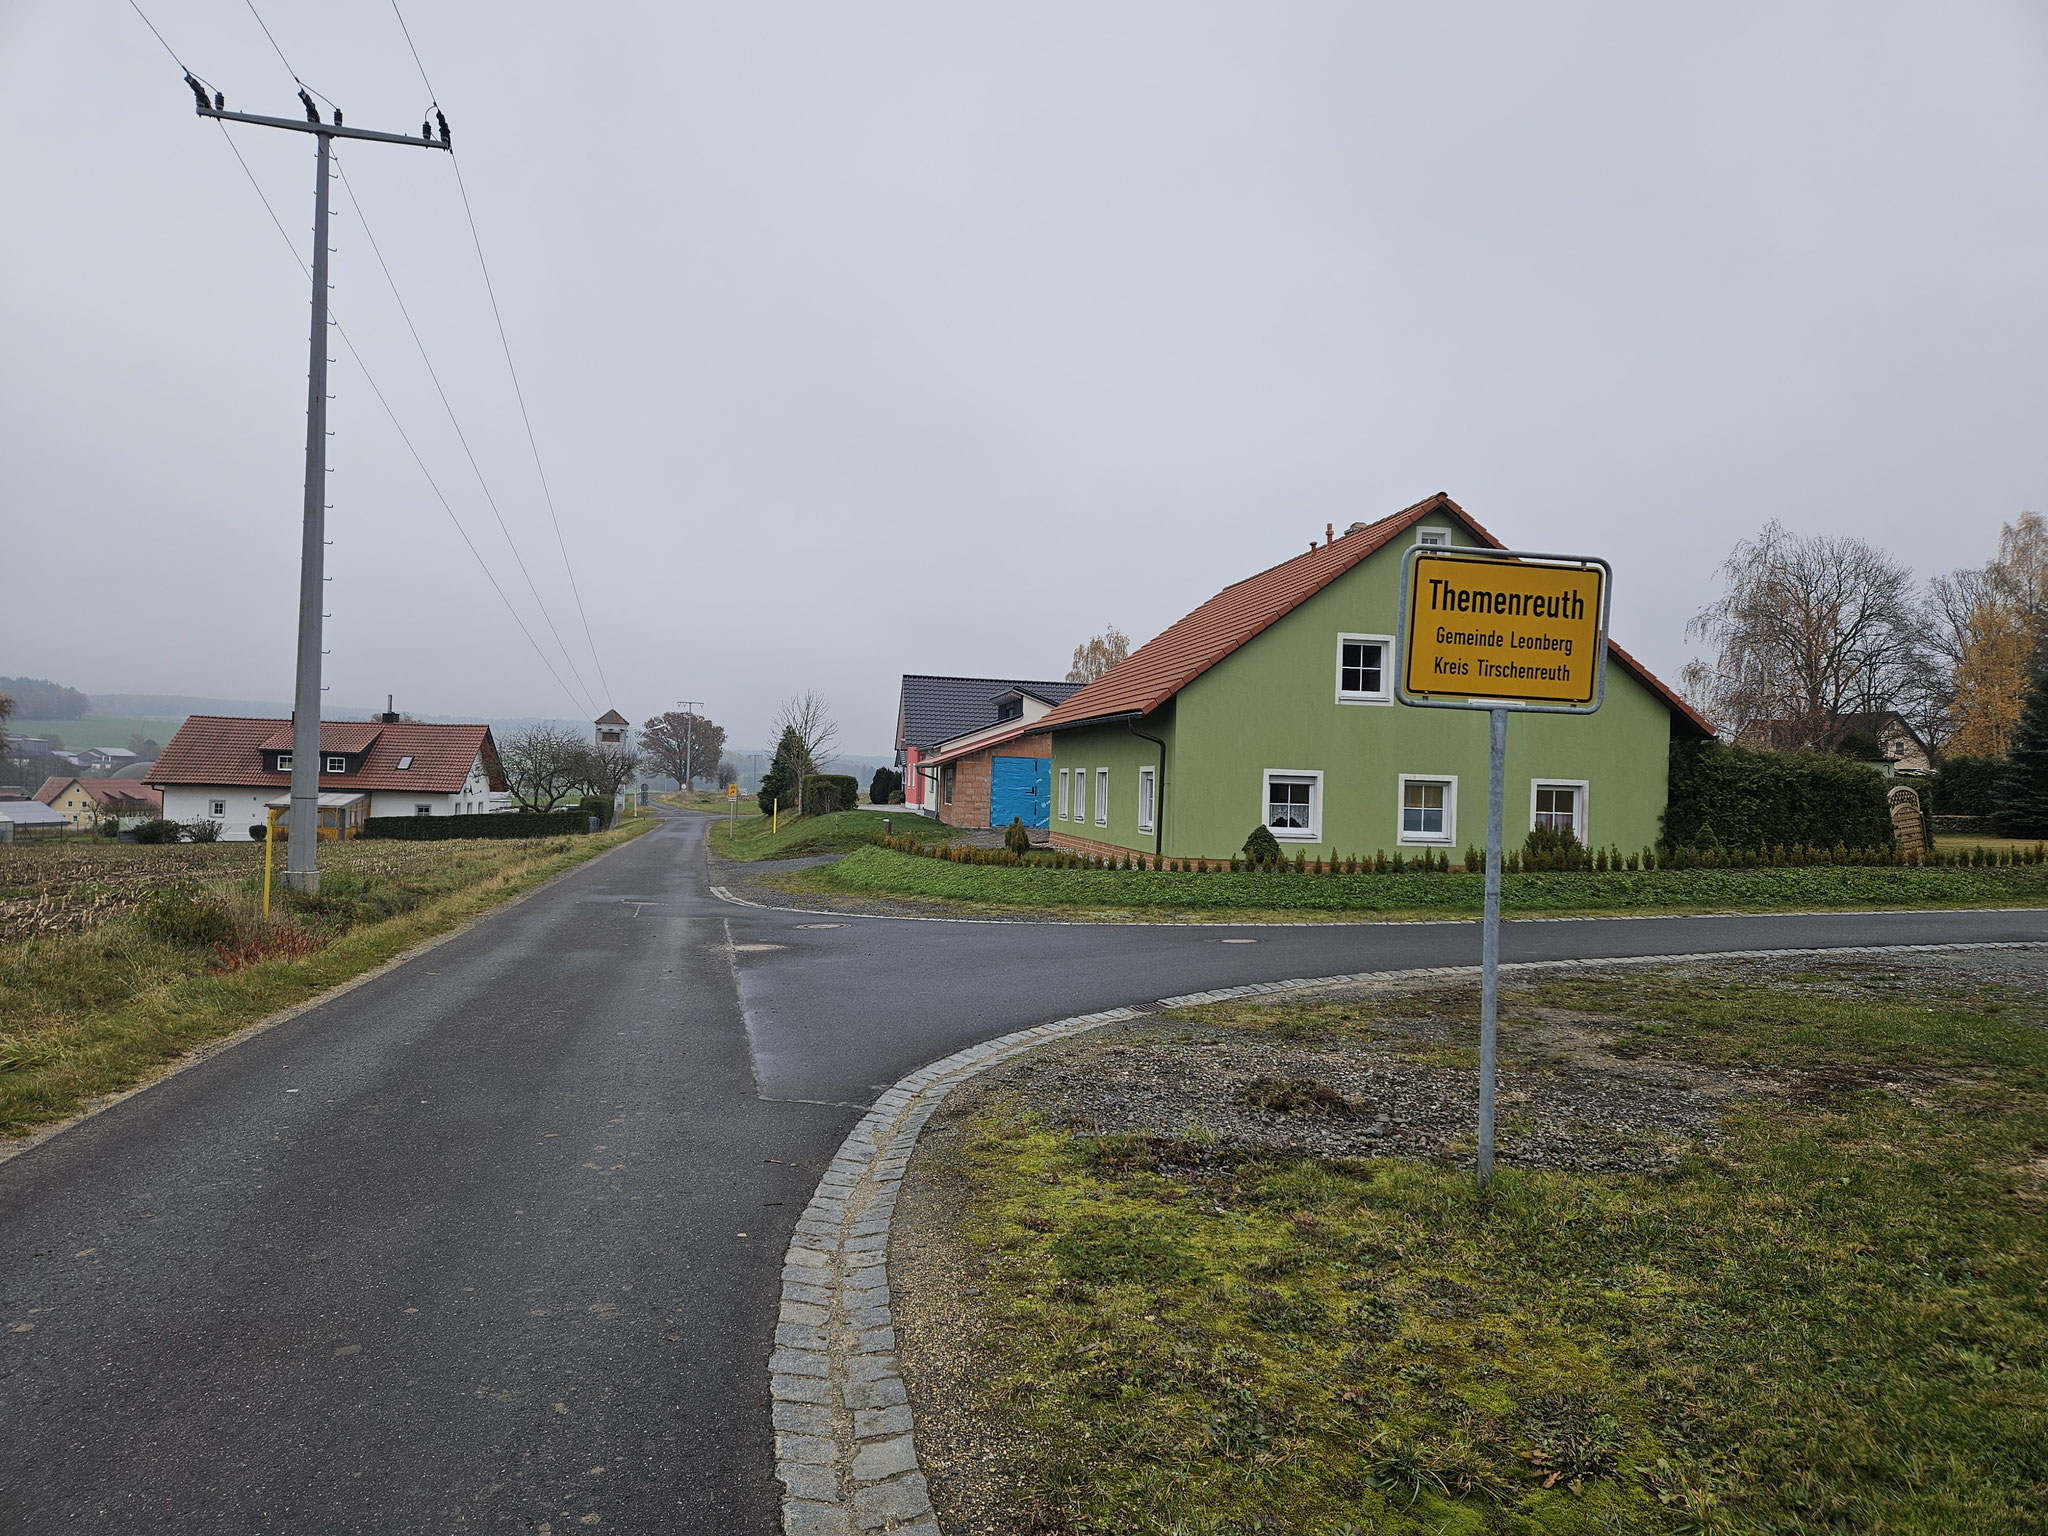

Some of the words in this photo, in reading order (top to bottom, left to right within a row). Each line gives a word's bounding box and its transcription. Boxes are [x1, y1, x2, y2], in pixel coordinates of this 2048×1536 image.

[1429, 579, 1584, 620] Themenreuth
[1436, 626, 1503, 647] Gemeinde
[1510, 631, 1573, 656] Leonberg
[1434, 656, 1469, 675] Kreis
[1477, 659, 1570, 681] Tirschenreuth
